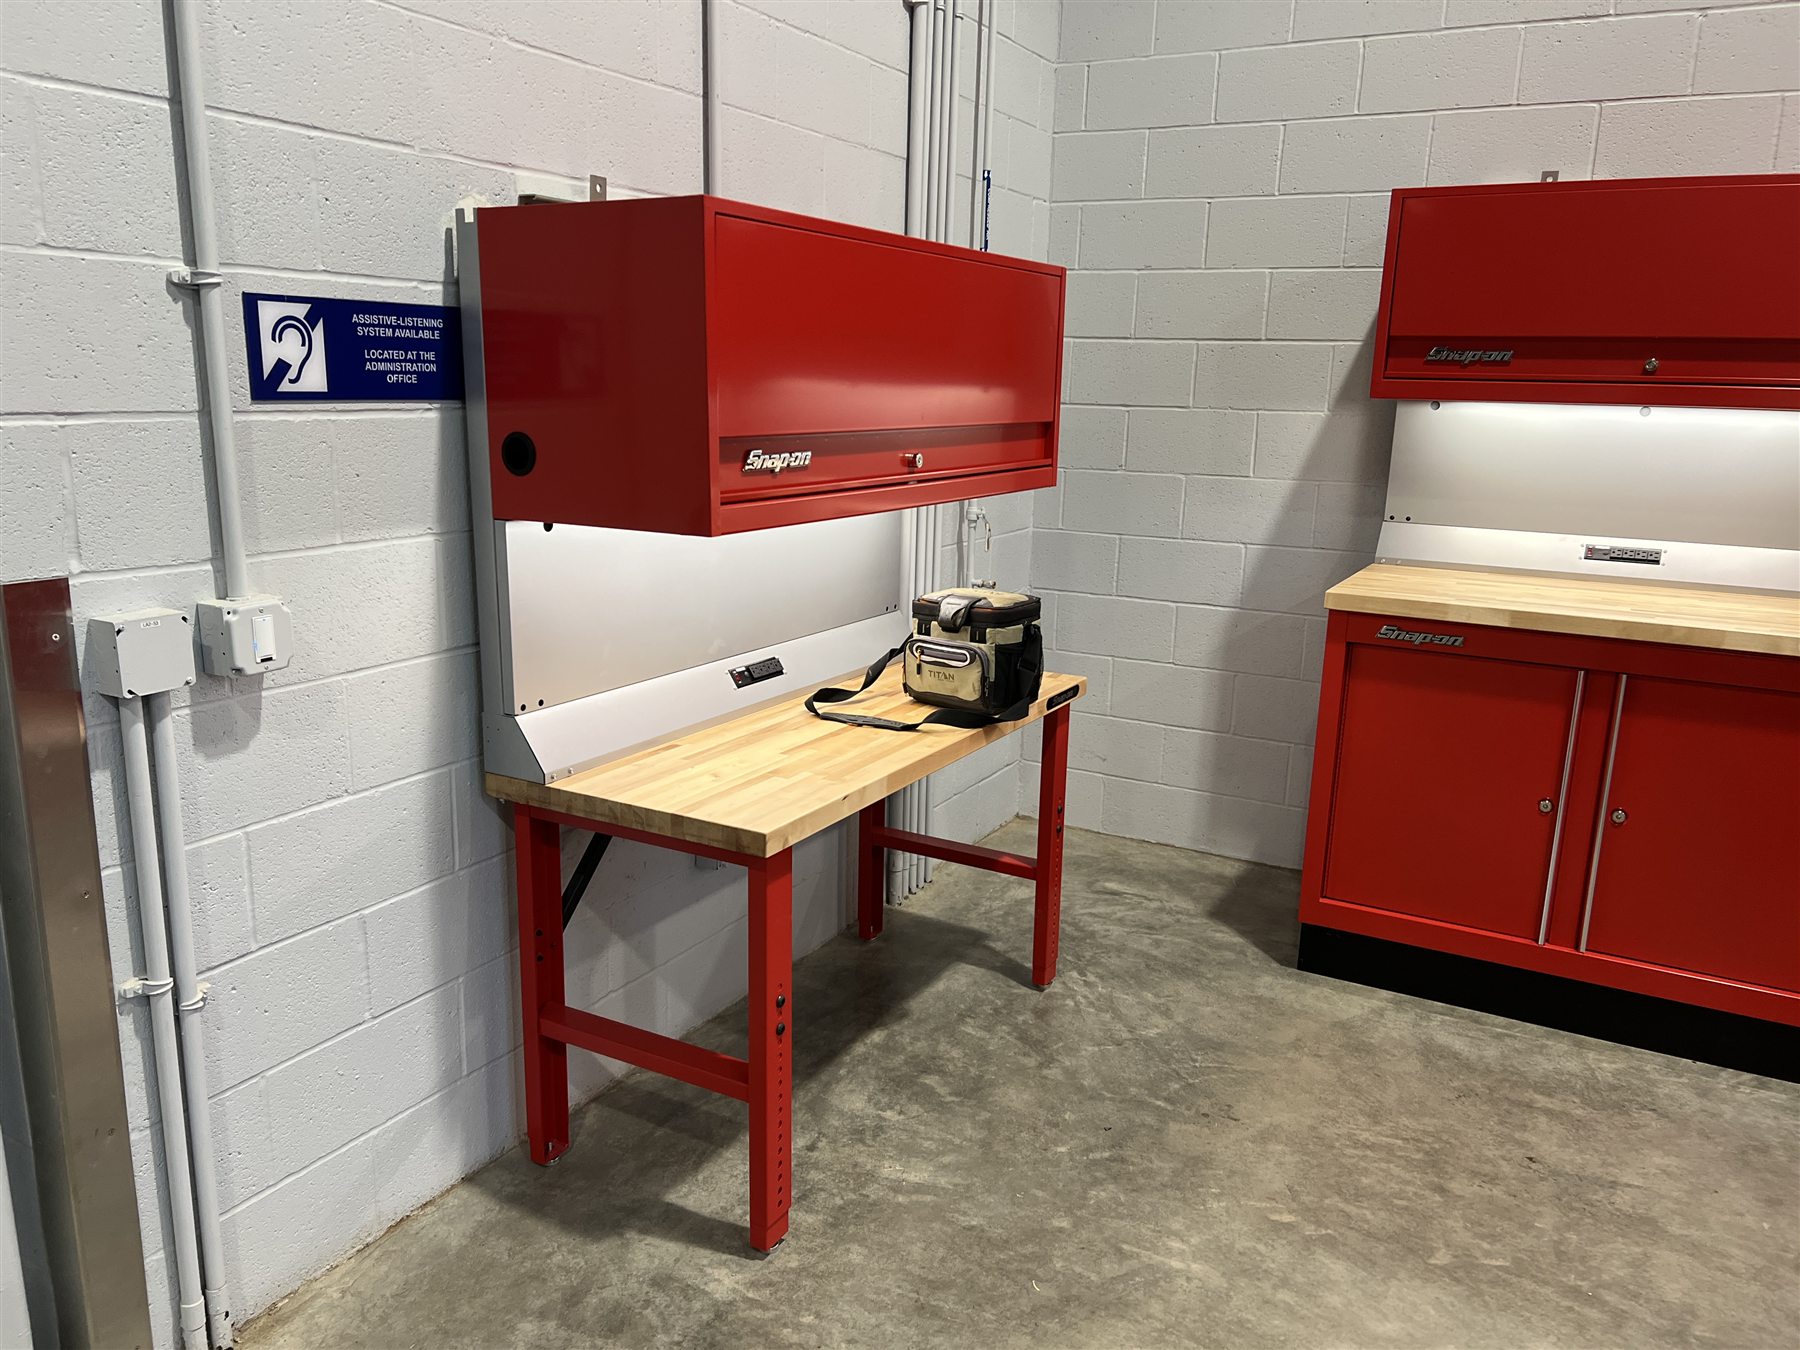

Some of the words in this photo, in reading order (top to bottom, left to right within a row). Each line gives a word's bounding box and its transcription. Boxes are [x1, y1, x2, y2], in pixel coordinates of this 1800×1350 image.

[352, 314, 443, 328] ASSISTIVE-LISTENING
[357, 326, 393, 337] SYSTEM
[395, 328, 440, 339] AVAILABLE
[364, 349, 405, 360] LOCATED
[407, 351, 417, 360] AT
[419, 351, 436, 361] THE
[1425, 346, 1513, 364] Snap-on
[365, 361, 437, 372] ADMINISTRATION
[386, 374, 418, 384] OFFICE
[743, 449, 812, 473] Snap-on
[1375, 625, 1464, 646] Snap-on
[928, 669, 955, 680] TITAN
